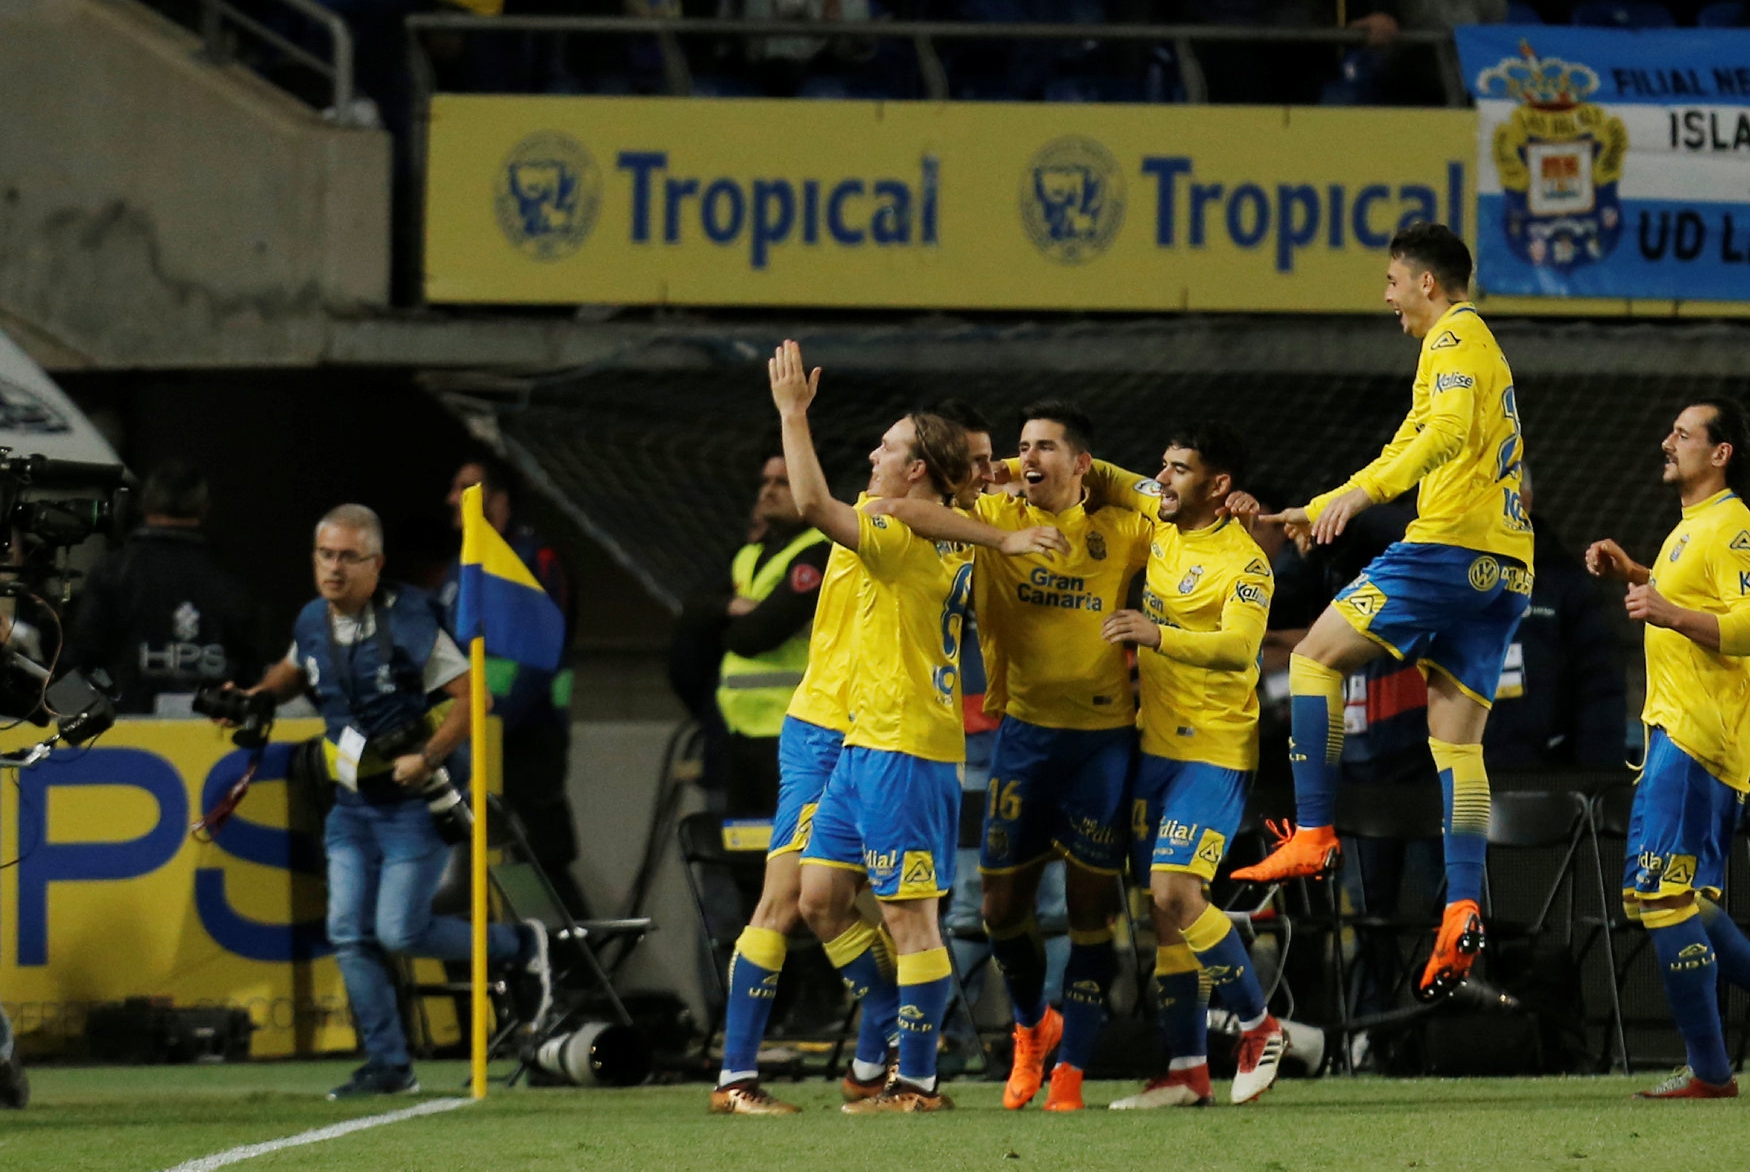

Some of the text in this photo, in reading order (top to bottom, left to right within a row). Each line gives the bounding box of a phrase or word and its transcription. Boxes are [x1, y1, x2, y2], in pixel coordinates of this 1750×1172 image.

[1612, 67, 1706, 98] FILIAL
[617, 151, 939, 269] Tropical
[1141, 156, 1464, 272] Tropical
[1638, 211, 1705, 262] UD
[1017, 581, 1103, 612] Canaria
[1030, 566, 1085, 593] Gran
[138, 639, 229, 677] HPS
[988, 777, 1023, 821] 16
